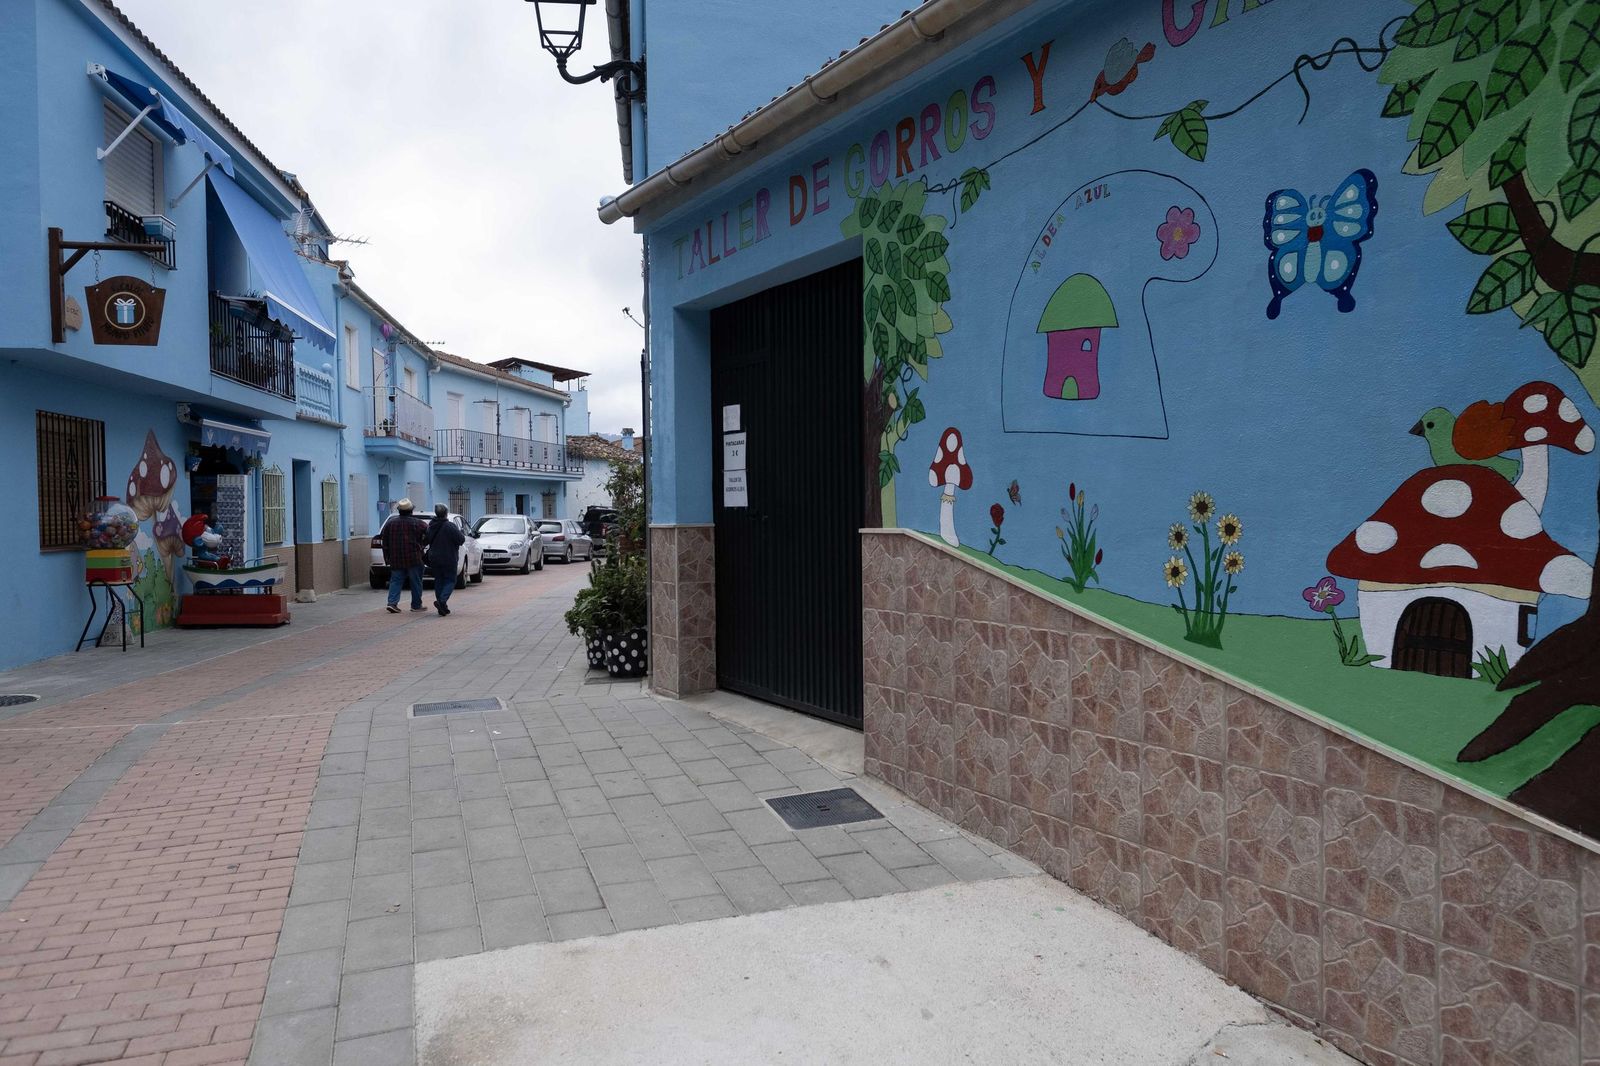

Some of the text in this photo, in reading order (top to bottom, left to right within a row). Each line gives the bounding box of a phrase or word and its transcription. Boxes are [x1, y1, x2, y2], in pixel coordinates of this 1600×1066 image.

[672, 39, 1056, 281] TALLER DE GORROS Y
[1075, 183, 1111, 210] AZUL
